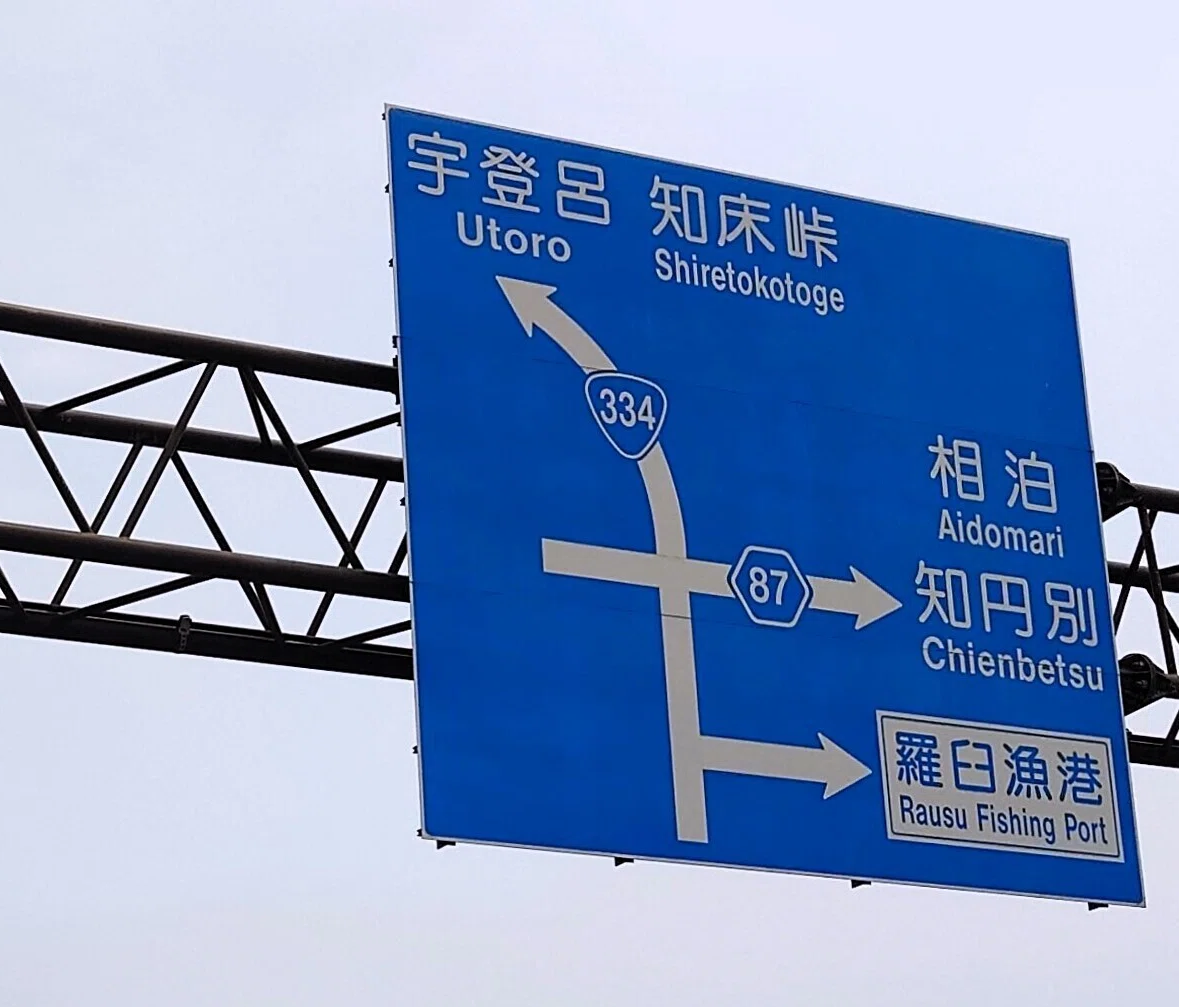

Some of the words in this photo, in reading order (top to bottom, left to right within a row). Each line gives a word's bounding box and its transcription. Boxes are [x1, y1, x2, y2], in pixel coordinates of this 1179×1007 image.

[408, 131, 611, 226] 宇登呂
[457, 211, 572, 262] Utoro
[648, 175, 839, 268] 知床峠
[655, 247, 845, 316] Shiretokotoge
[599, 388, 656, 431] 334
[938, 509, 1064, 558] Aidomari
[748, 566, 789, 606] 87
[915, 561, 1099, 648] 知円別
[922, 635, 1104, 691] Chienbetsu
[895, 731, 1103, 806] 羅臼漁港
[899, 794, 968, 830] Rausu
[976, 803, 1056, 845] Fishing
[1063, 812, 1109, 846] Port
